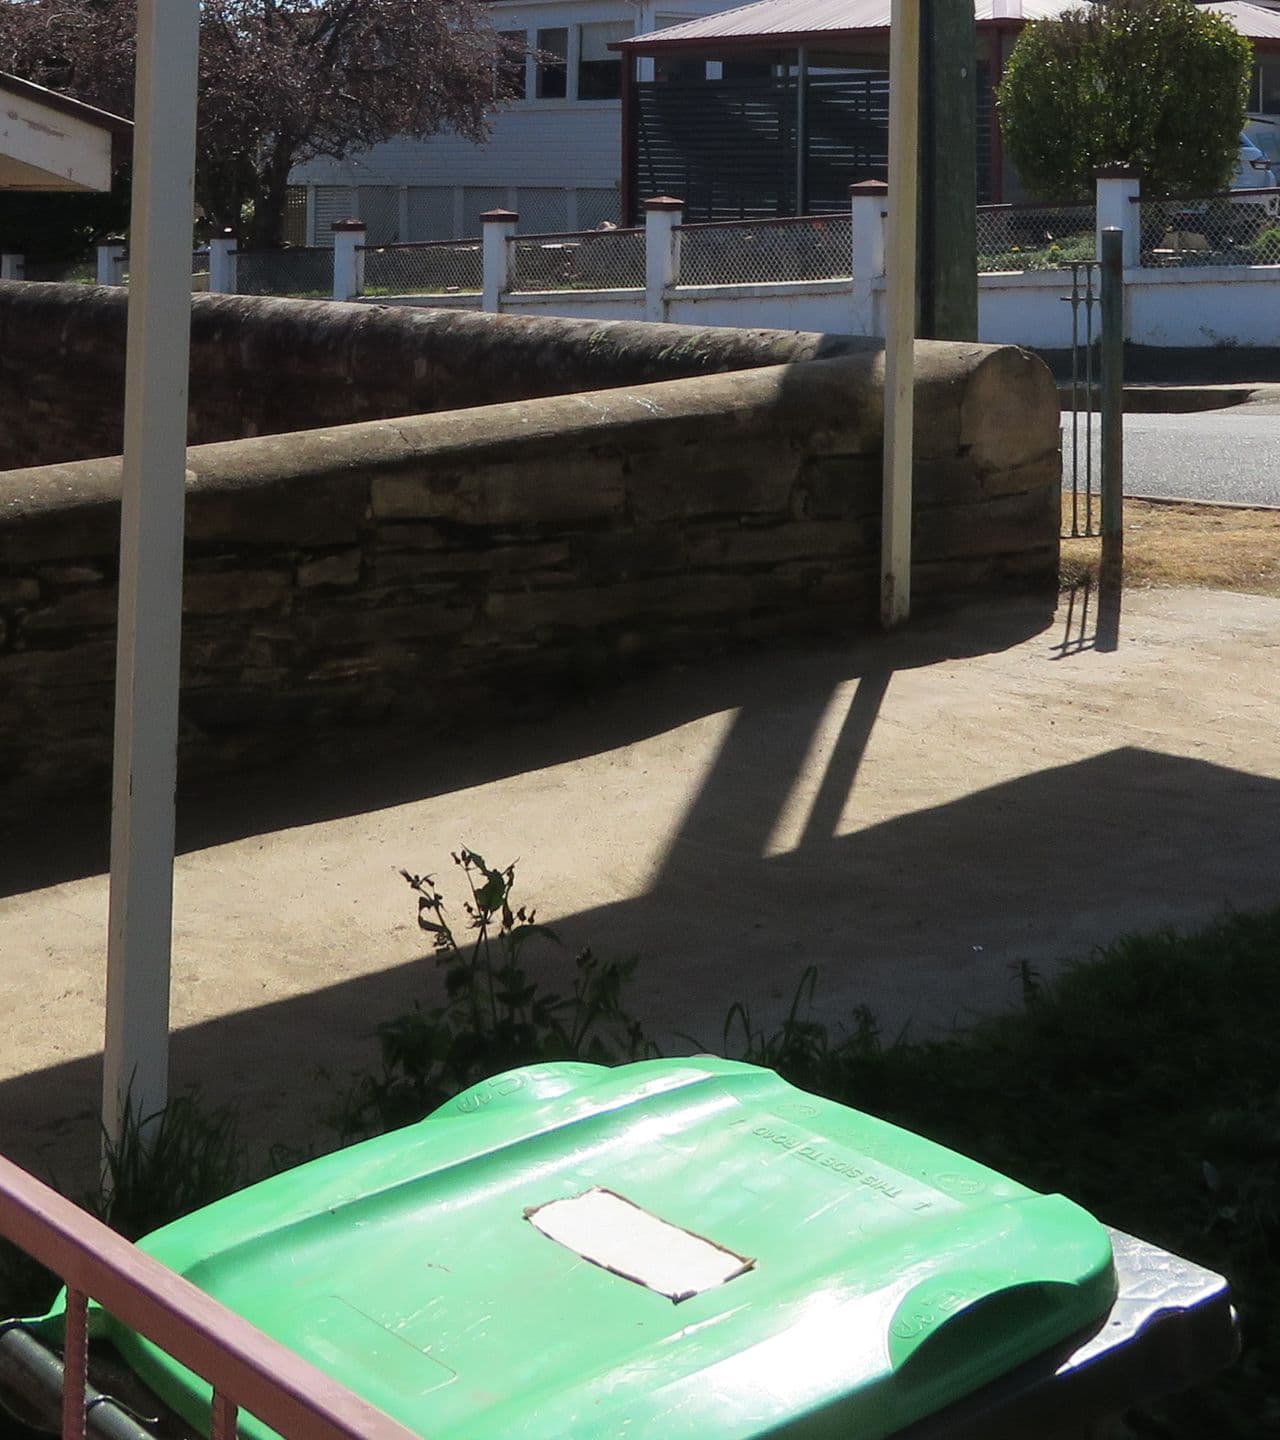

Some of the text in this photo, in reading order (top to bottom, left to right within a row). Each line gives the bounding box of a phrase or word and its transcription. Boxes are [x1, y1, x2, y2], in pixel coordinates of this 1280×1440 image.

[751, 1126, 801, 1150] ROAD
[799, 1144, 825, 1163] TO
[820, 1156, 864, 1179] SIDE
[860, 1175, 904, 1199] THIS
